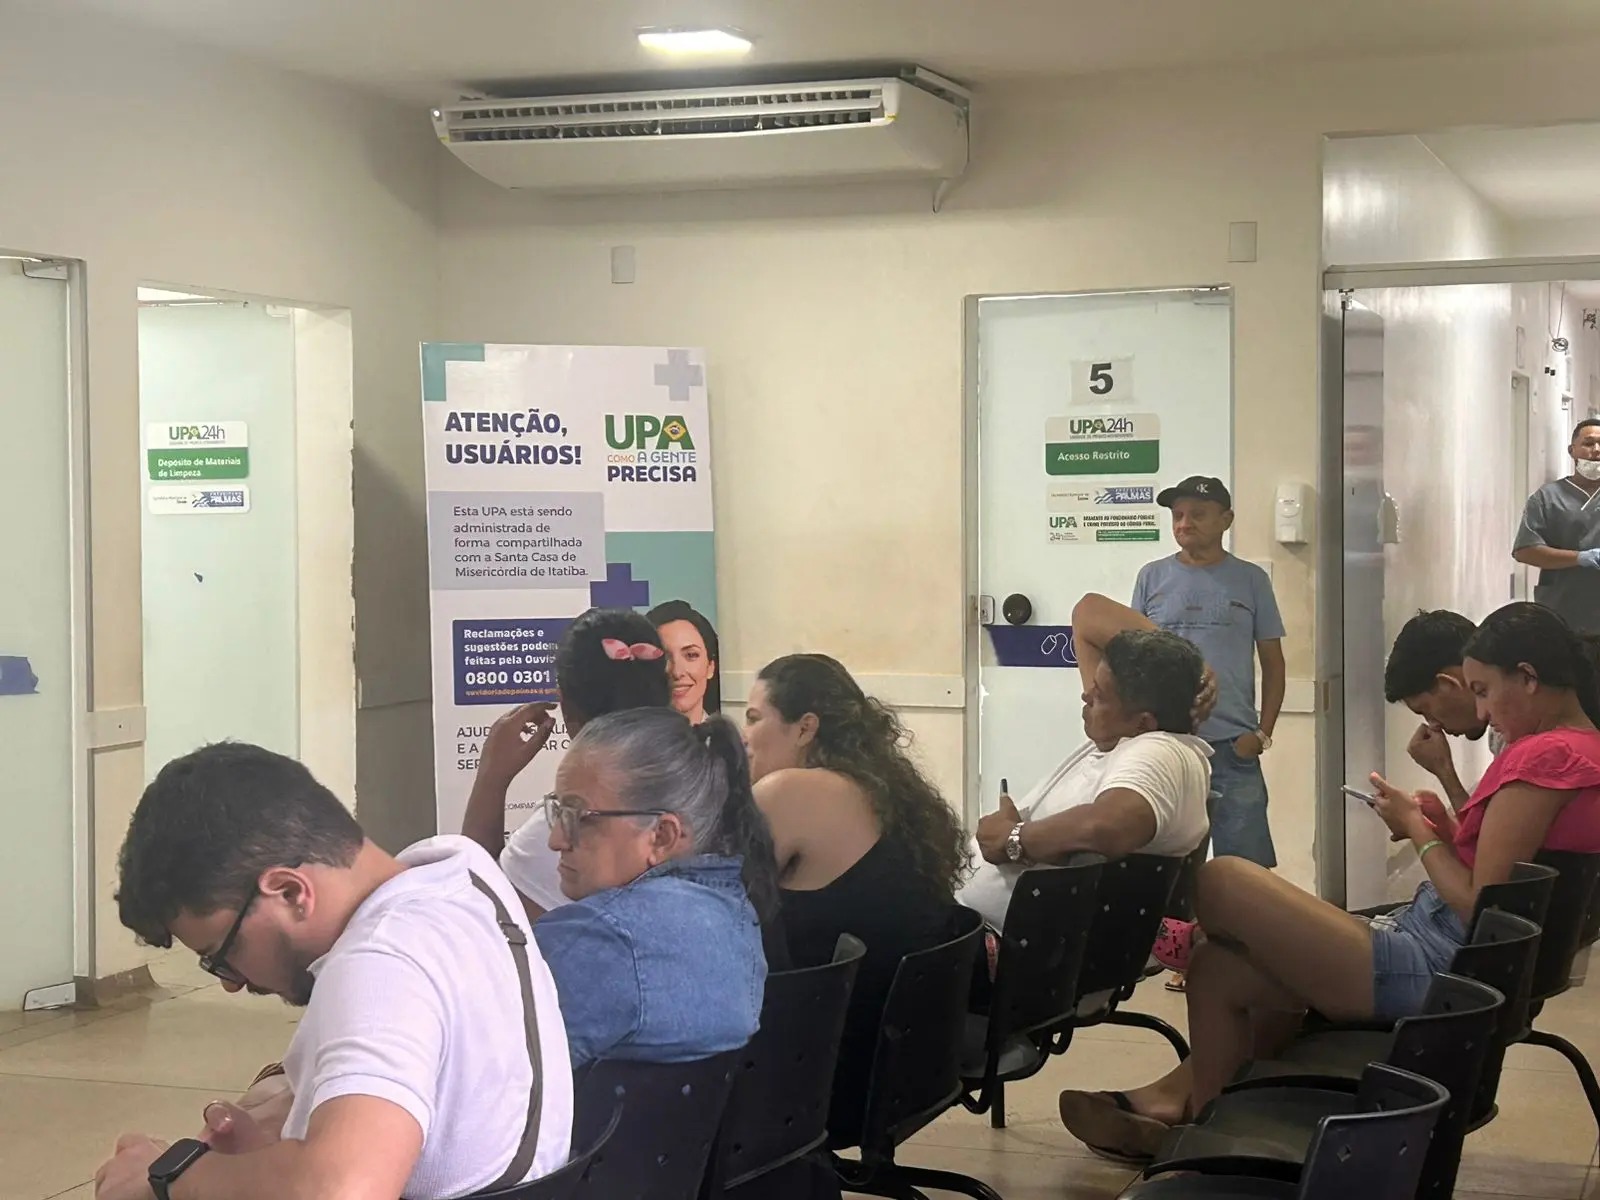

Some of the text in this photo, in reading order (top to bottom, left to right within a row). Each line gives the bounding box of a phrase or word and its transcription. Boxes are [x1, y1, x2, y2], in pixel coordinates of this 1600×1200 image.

[1089, 362, 1114, 395] 5
[444, 408, 568, 438] ATENÇÃO,
[604, 414, 696, 450] UPA
[445, 440, 582, 465] USUÁRIOS!
[607, 451, 696, 463] COMO A GENTE
[1057, 449, 1130, 461] Acesso Restrito
[193, 457, 204, 466] de
[205, 455, 241, 465] Materiais
[169, 469, 202, 478] Limpeza
[607, 465, 697, 482] PRECISA
[1115, 491, 1151, 501] PALMAS
[453, 506, 573, 517] Esta UPA está sendo
[453, 523, 551, 533] administrada de
[1049, 516, 1077, 528] UPA
[454, 537, 583, 549] forma compartilhada
[454, 552, 577, 562] com a Santa Casa de
[455, 565, 588, 577] Misericórdia de Itatiba.
[464, 628, 544, 640] Reclamações e
[464, 641, 519, 653] sugestões
[464, 656, 496, 666] feitas
[498, 655, 523, 666] pela
[465, 670, 551, 685] 0800 0301
[456, 726, 492, 738] AJUD
[457, 743, 465, 754] E
[469, 743, 479, 754] A
